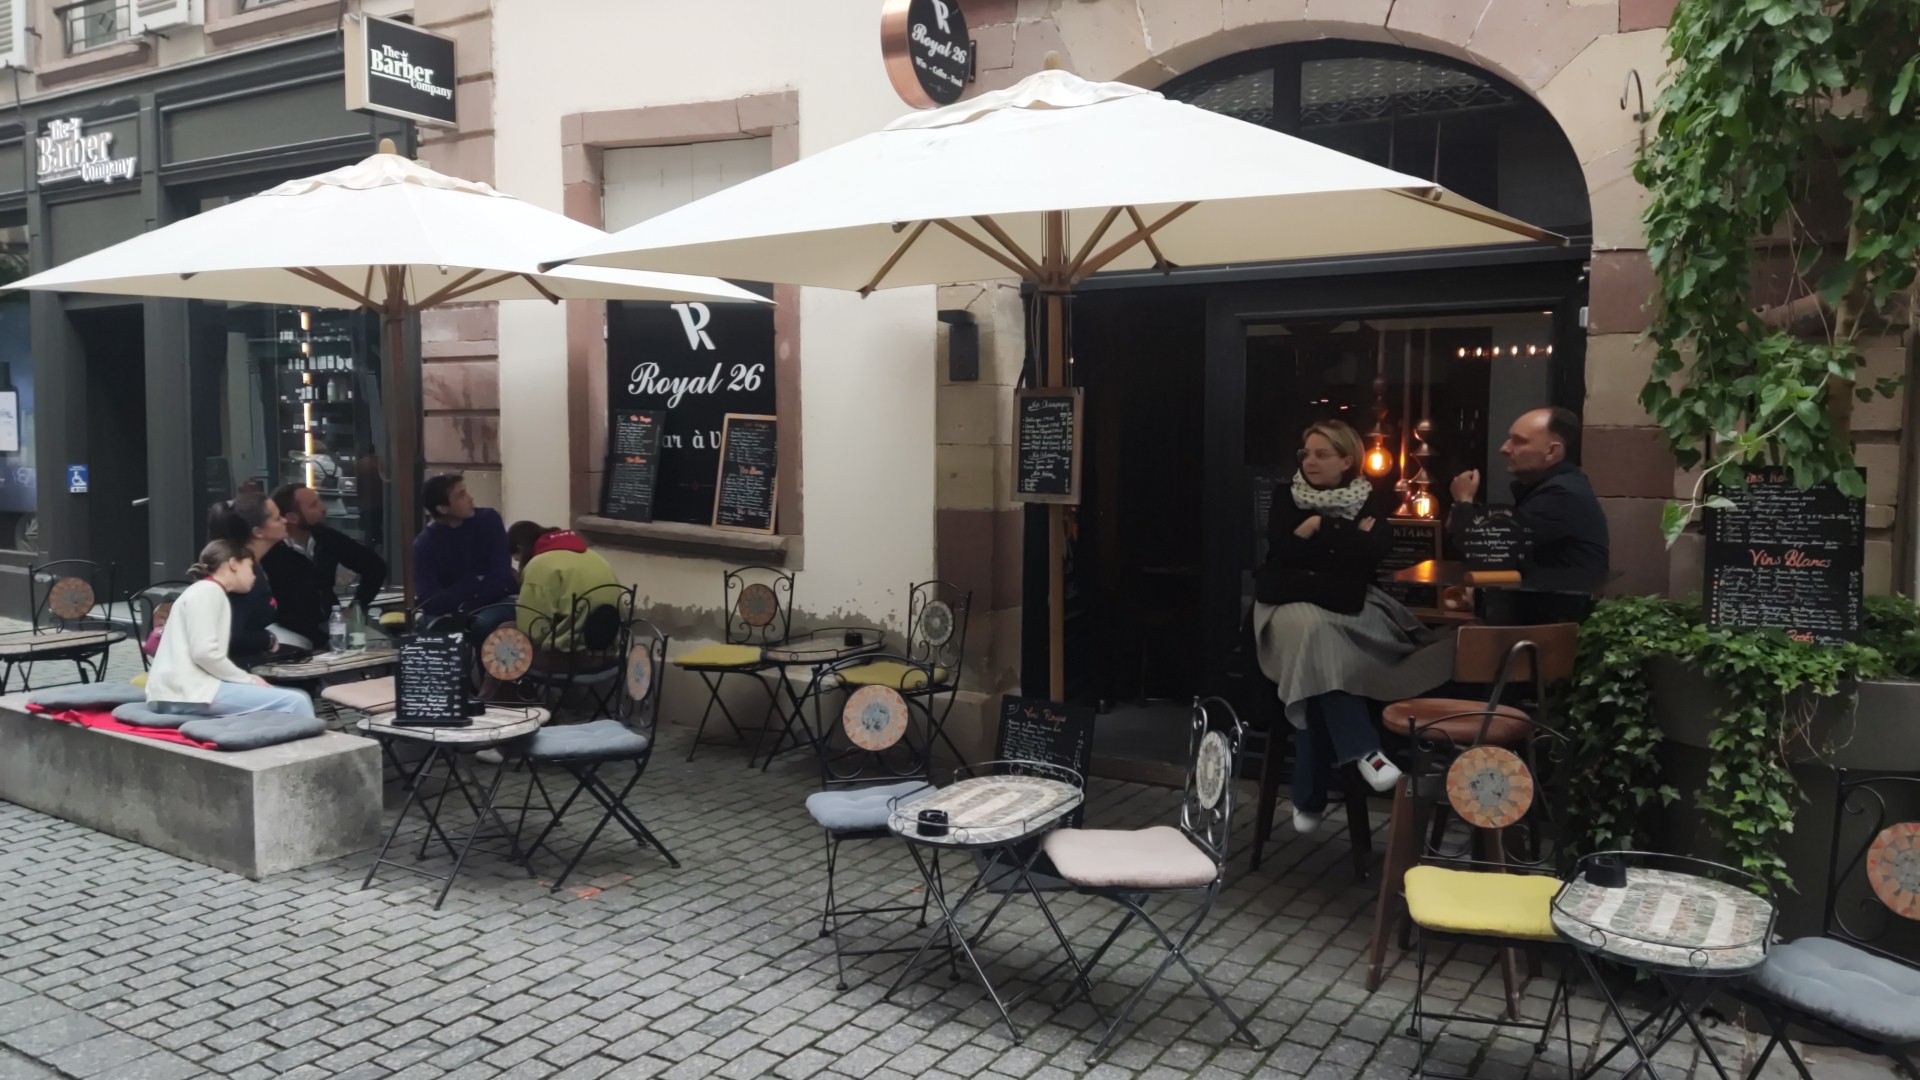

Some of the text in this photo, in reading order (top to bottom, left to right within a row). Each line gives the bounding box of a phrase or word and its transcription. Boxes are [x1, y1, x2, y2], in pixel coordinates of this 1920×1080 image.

[382, 44, 400, 59] The
[911, 23, 968, 64] Royal 26
[370, 48, 434, 85] Barber
[410, 77, 453, 100] Company
[47, 119, 70, 140] The
[36, 129, 112, 175] Barber
[81, 156, 137, 183] Company
[628, 361, 765, 409] Royal 26
[662, 434, 683, 449] ar
[692, 429, 706, 449] à
[1749, 548, 1832, 568] Vins Blancs
